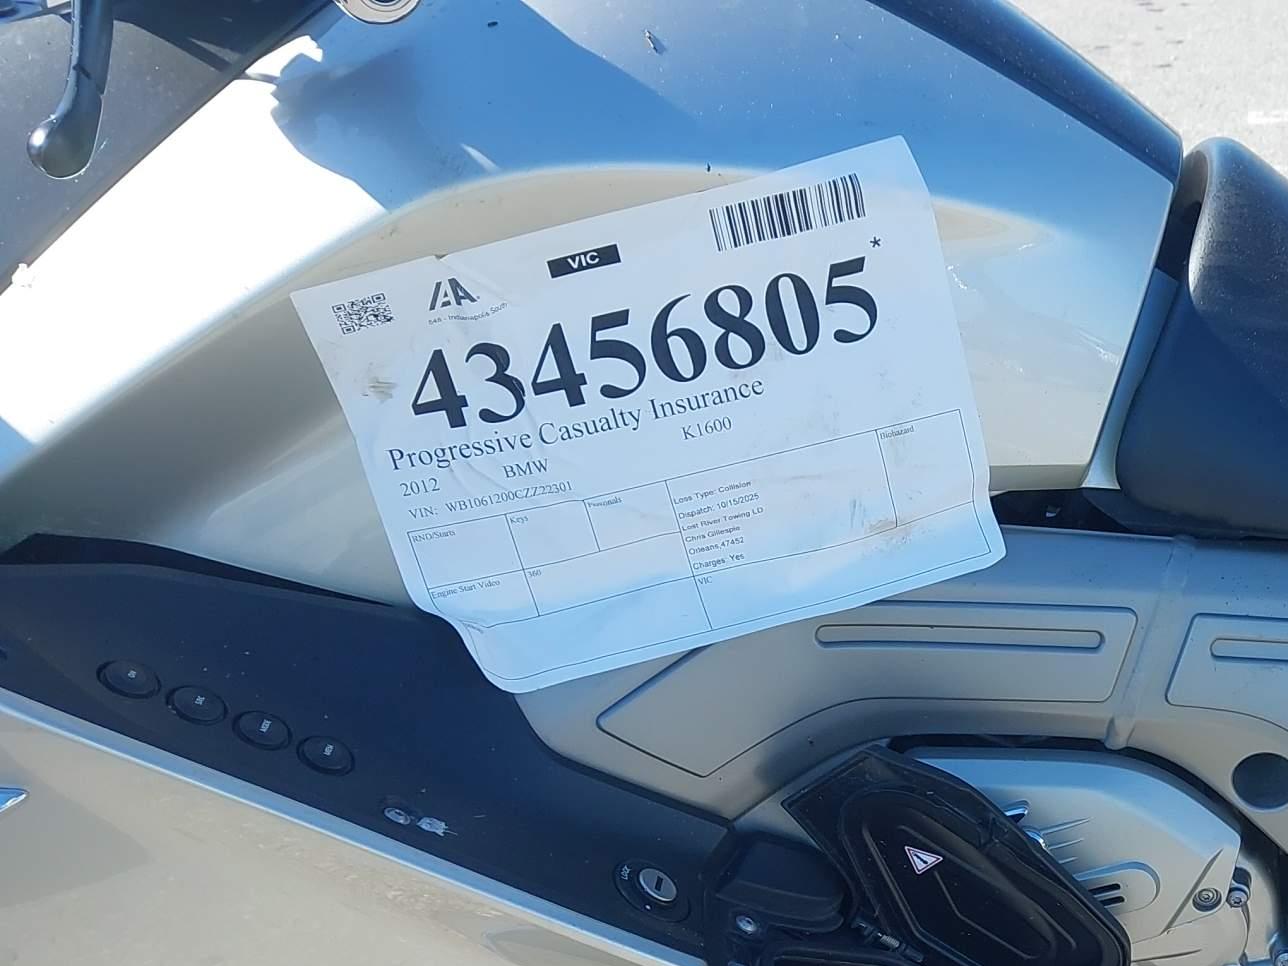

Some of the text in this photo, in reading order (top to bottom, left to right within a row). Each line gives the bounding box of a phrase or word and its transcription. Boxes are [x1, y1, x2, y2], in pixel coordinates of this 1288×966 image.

[567, 252, 600, 269] VIC
[490, 302, 508, 314] South
[410, 255, 879, 429] 43456805
[386, 380, 765, 470] Progressive Casualty Insurance
[400, 416, 732, 497] 2012 BMW K1600
[412, 530, 456, 543] RND/Starts
[510, 515, 529, 525] Keys
[880, 425, 914, 440] Biohazard
[673, 480, 752, 505] Loss Type: Collision
[408, 480, 573, 519] VIN: WB1061200CZZ22301
[678, 493, 760, 520] Dispatch: 10/15/2025
[682, 523, 699, 532] Lost
[701, 518, 721, 528] River
[723, 511, 751, 522] Towing
[685, 525, 741, 543] Chris Gillespie
[688, 536, 745, 555] Orleans,47452
[729, 553, 745, 561] Yes
[431, 570, 542, 600] Engine Start Video 360
[697, 575, 713, 585] VIC
